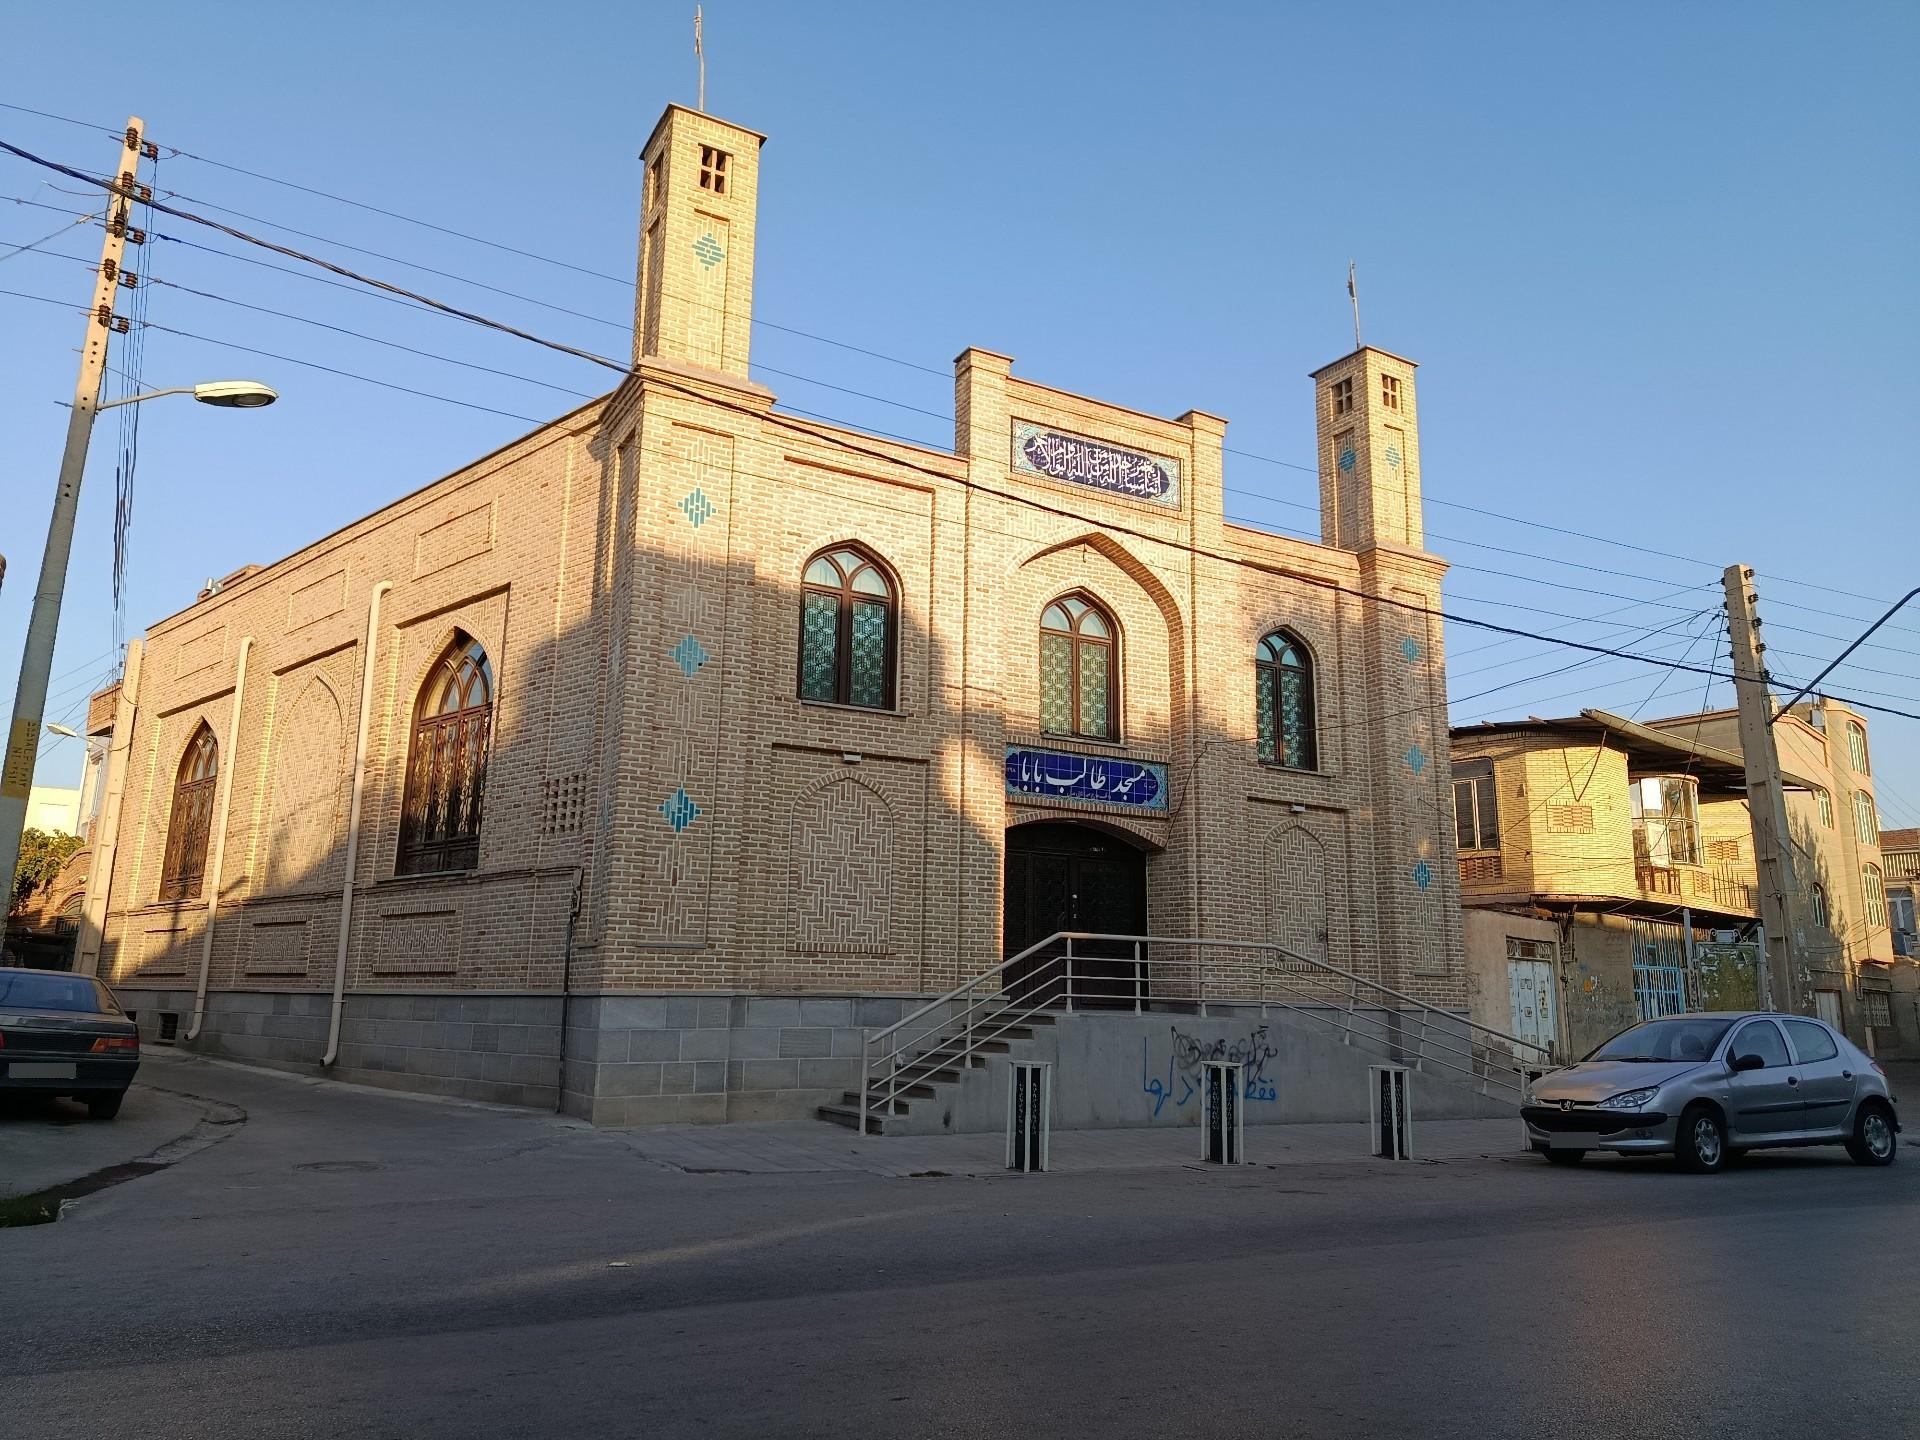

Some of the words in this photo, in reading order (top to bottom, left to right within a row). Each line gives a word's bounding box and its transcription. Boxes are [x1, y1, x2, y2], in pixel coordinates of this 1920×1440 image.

[1022, 756, 1042, 792] بابا
[1046, 758, 1106, 794] طالب
[1111, 769, 1146, 801] مسجد
